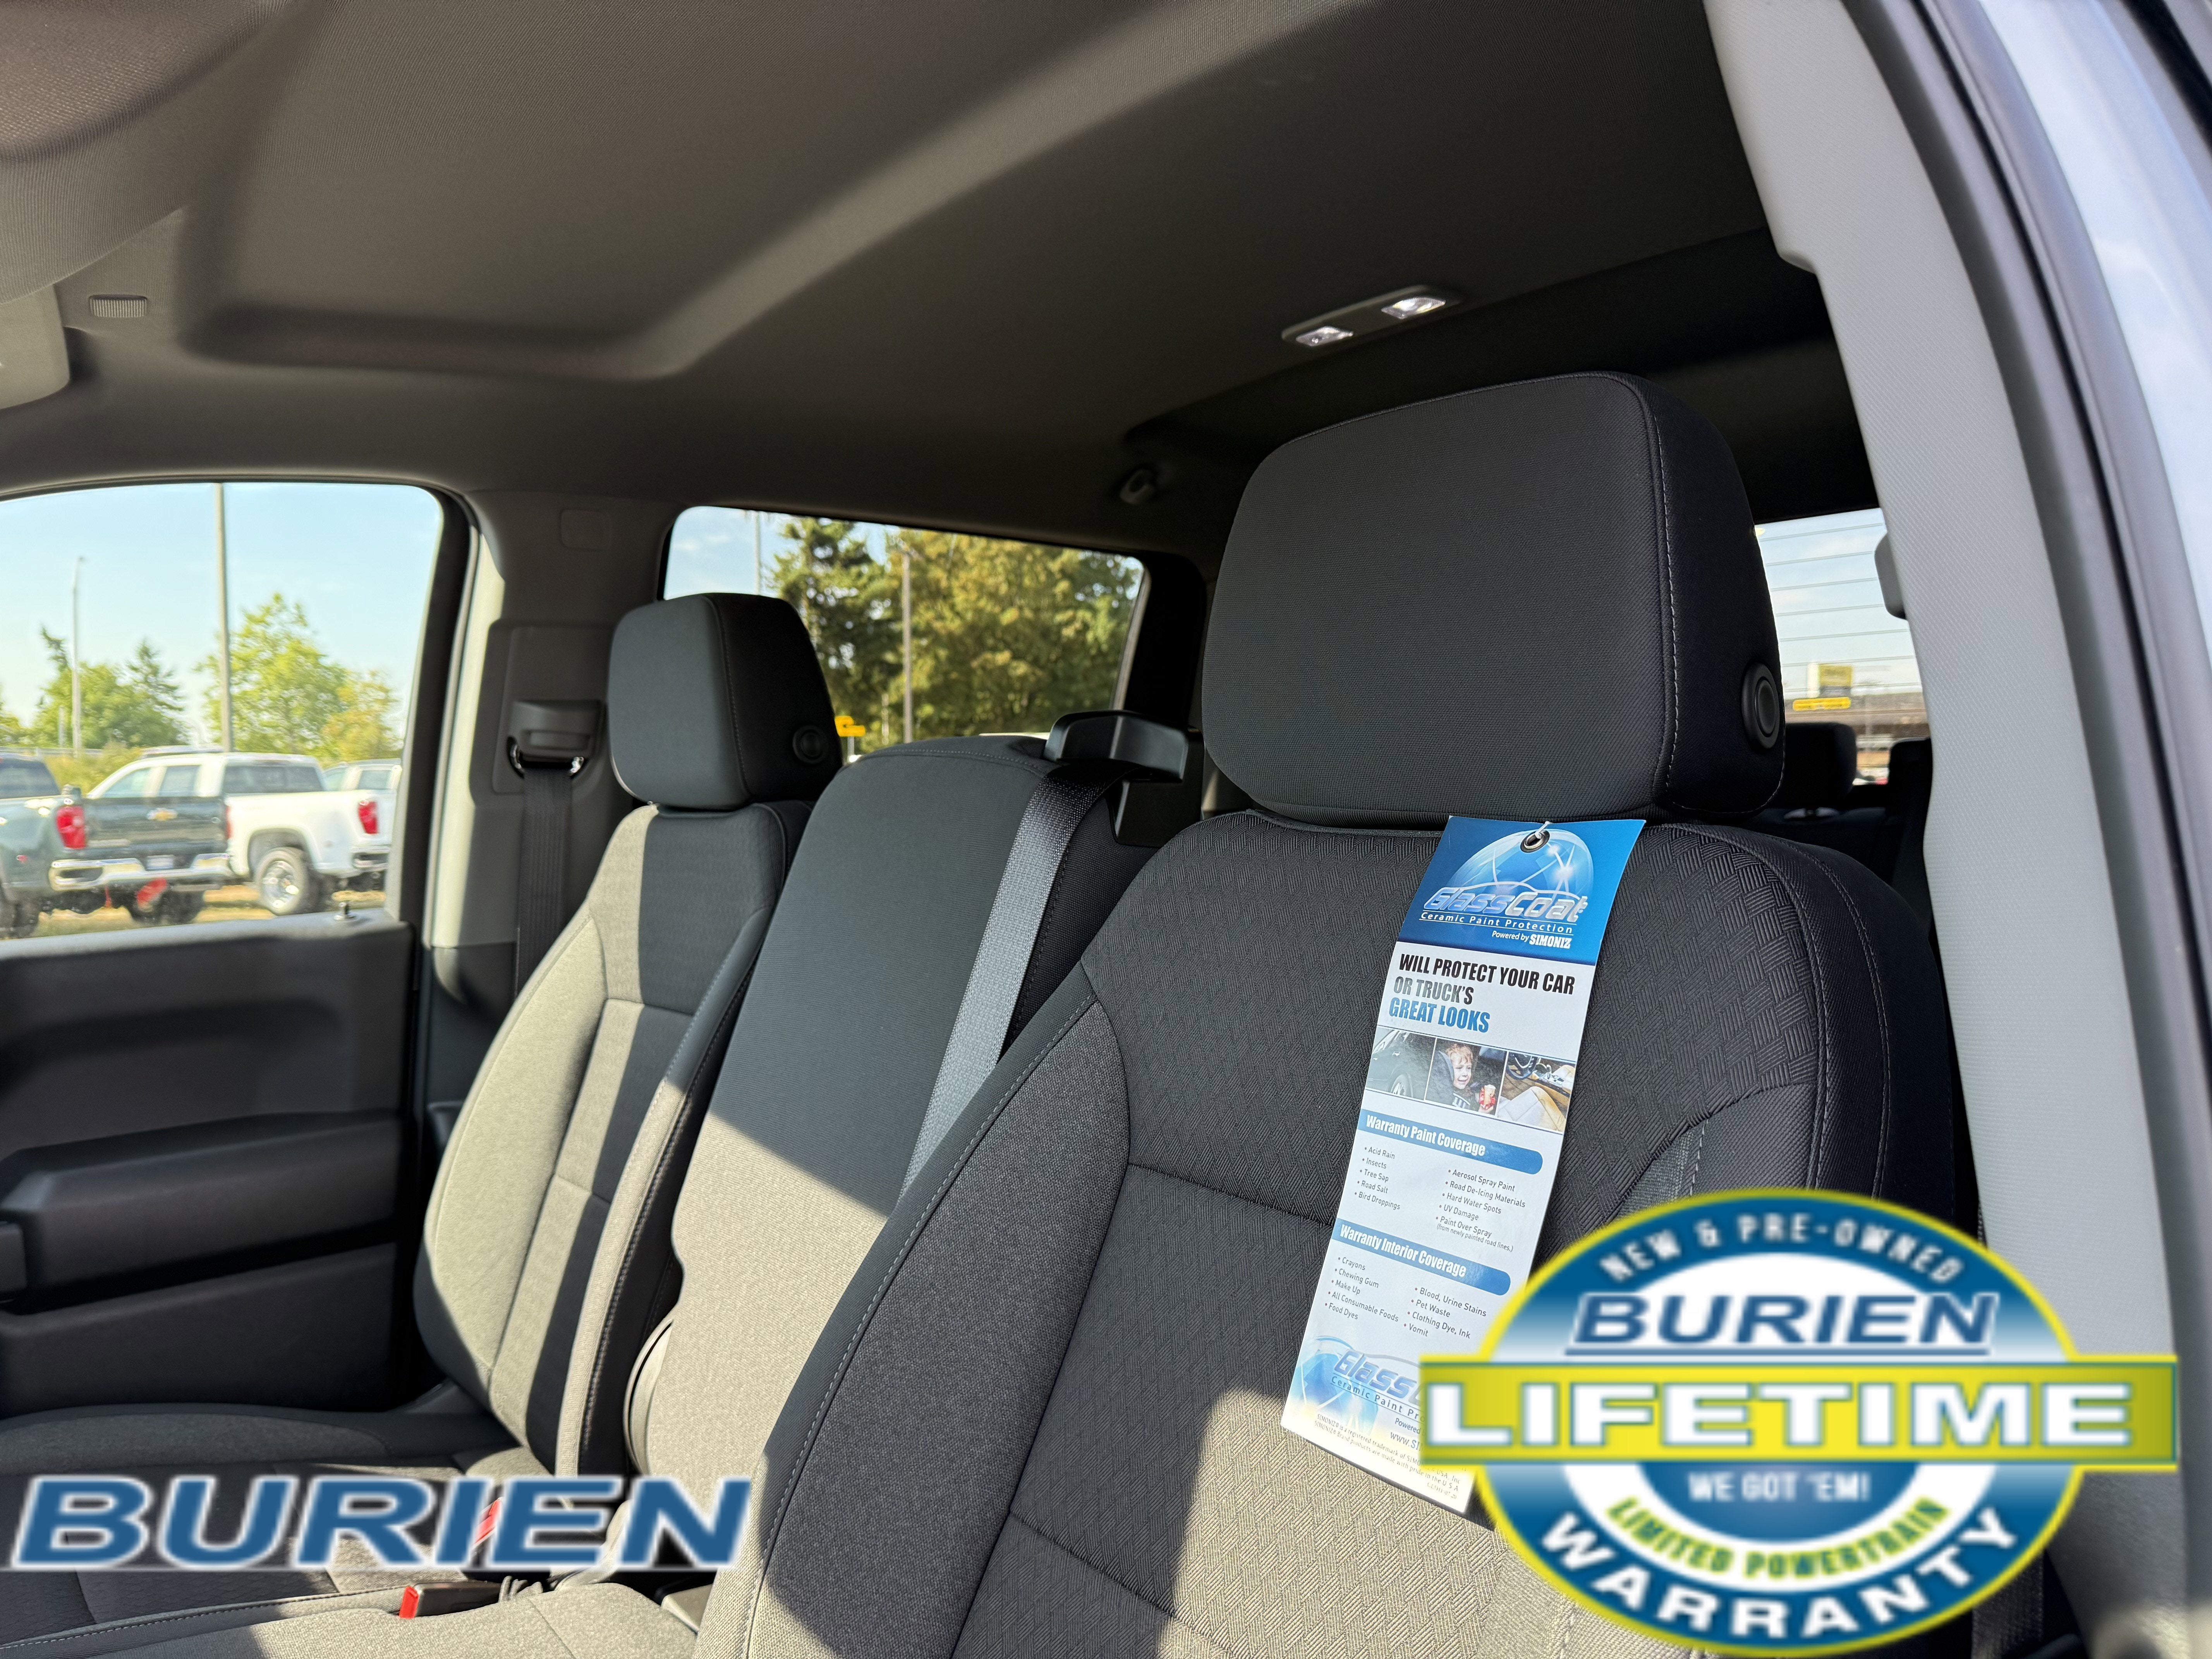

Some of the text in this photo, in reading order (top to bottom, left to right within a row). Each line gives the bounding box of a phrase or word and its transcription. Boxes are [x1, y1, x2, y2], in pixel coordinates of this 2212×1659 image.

[1421, 912, 1572, 933] Ceramic Paint Protection
[1492, 931, 1572, 949] Powered by SIMONIZ
[1399, 954, 1575, 994] WILL PROTECT YOUR CAR
[1394, 976, 1474, 1005] OR TRUCK'S
[1389, 997, 1490, 1032] GREAT LOOKS
[1366, 1115, 1486, 1156] Warranty Paint Coverage
[1366, 1158, 1386, 1169] Insects
[1382, 1150, 1395, 1159] Rain
[1365, 1169, 1389, 1183] Tree Sap
[1453, 1170, 1515, 1191] Aerosol Spray Paint
[1362, 1180, 1388, 1193] Road Salt
[1450, 1181, 1525, 1207] Road De-Icing Materials
[1359, 1192, 1400, 1210] Bird Droppings
[1447, 1193, 1501, 1214] Hard Water Spots
[1454, 1207, 1479, 1221] Damage
[1437, 1223, 1449, 1232] (from
[1450, 1229, 1464, 1237] newly
[1465, 1233, 1484, 1242] painted
[1440, 1216, 1492, 1238] Paint Over Spray
[1340, 1224, 1467, 1277] Warranty Interior Coverage
[1342, 1257, 1365, 1270] Crayons
[1336, 1280, 1360, 1295] Make Up
[1339, 1269, 1379, 1288] Chewing Gum
[1329, 1303, 1358, 1319] Food Dyes
[1332, 1291, 1398, 1322] All Consumable Foods
[1416, 1300, 1450, 1317] Pet Waste
[1420, 1287, 1486, 1316] Blood, Urine Stains
[1409, 1323, 1428, 1336] Vomit
[1412, 1312, 1470, 1338] Clothing Dye, Ink
[1332, 1376, 1403, 1412] Ceramic Paint
[1395, 1418, 1421, 1434] Powered
[1373, 1441, 1398, 1456] trademark
